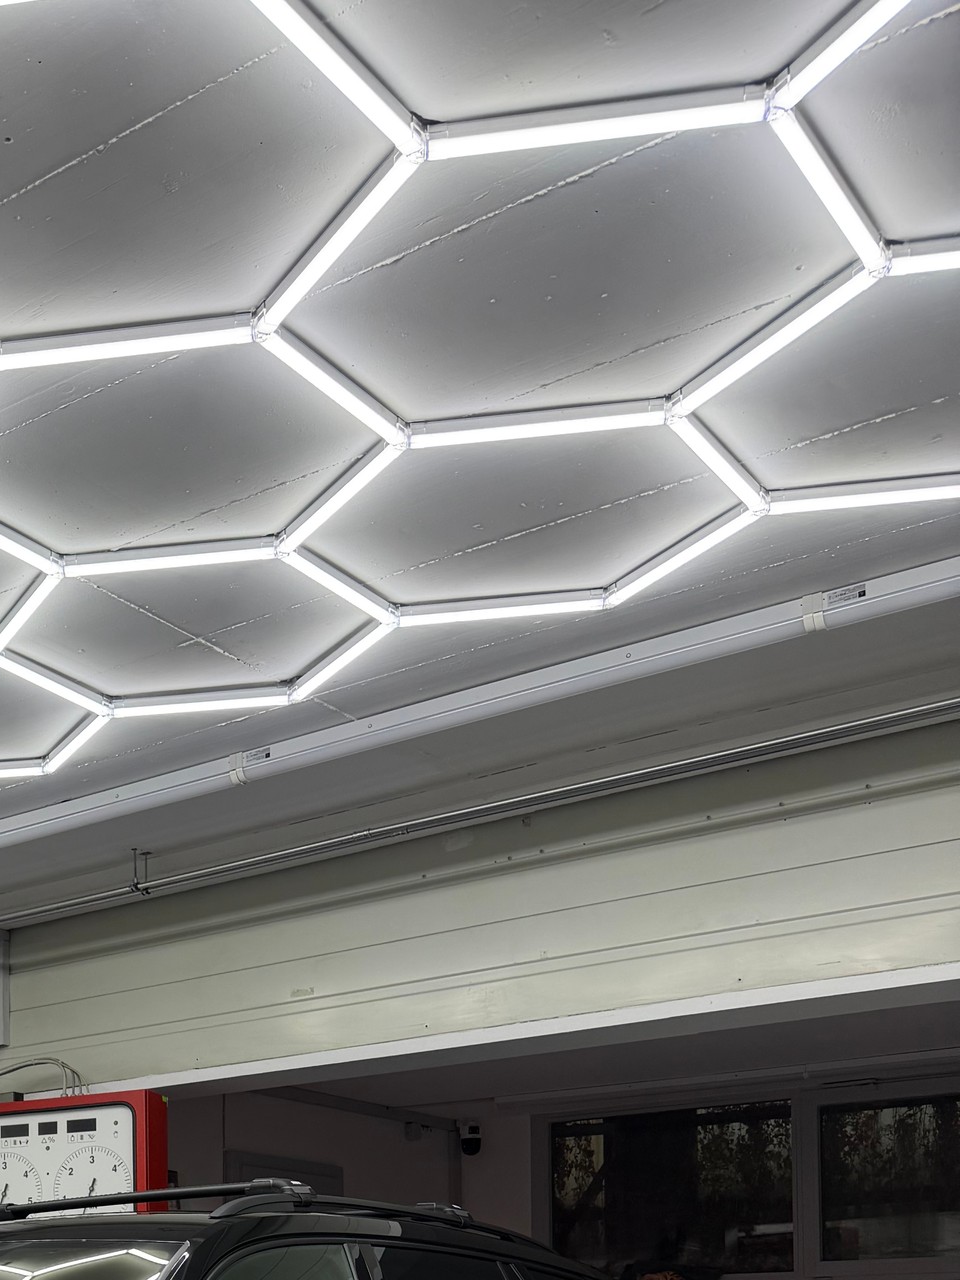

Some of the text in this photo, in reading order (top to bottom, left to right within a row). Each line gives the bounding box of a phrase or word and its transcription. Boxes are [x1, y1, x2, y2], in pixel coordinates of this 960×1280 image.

[89, 1155, 95, 1164] 3
[1, 1161, 8, 1170] 3
[111, 1164, 117, 1172] 4
[23, 1170, 29, 1178] 4
[68, 1167, 74, 1176] 2
[27, 1196, 33, 1204] 5
